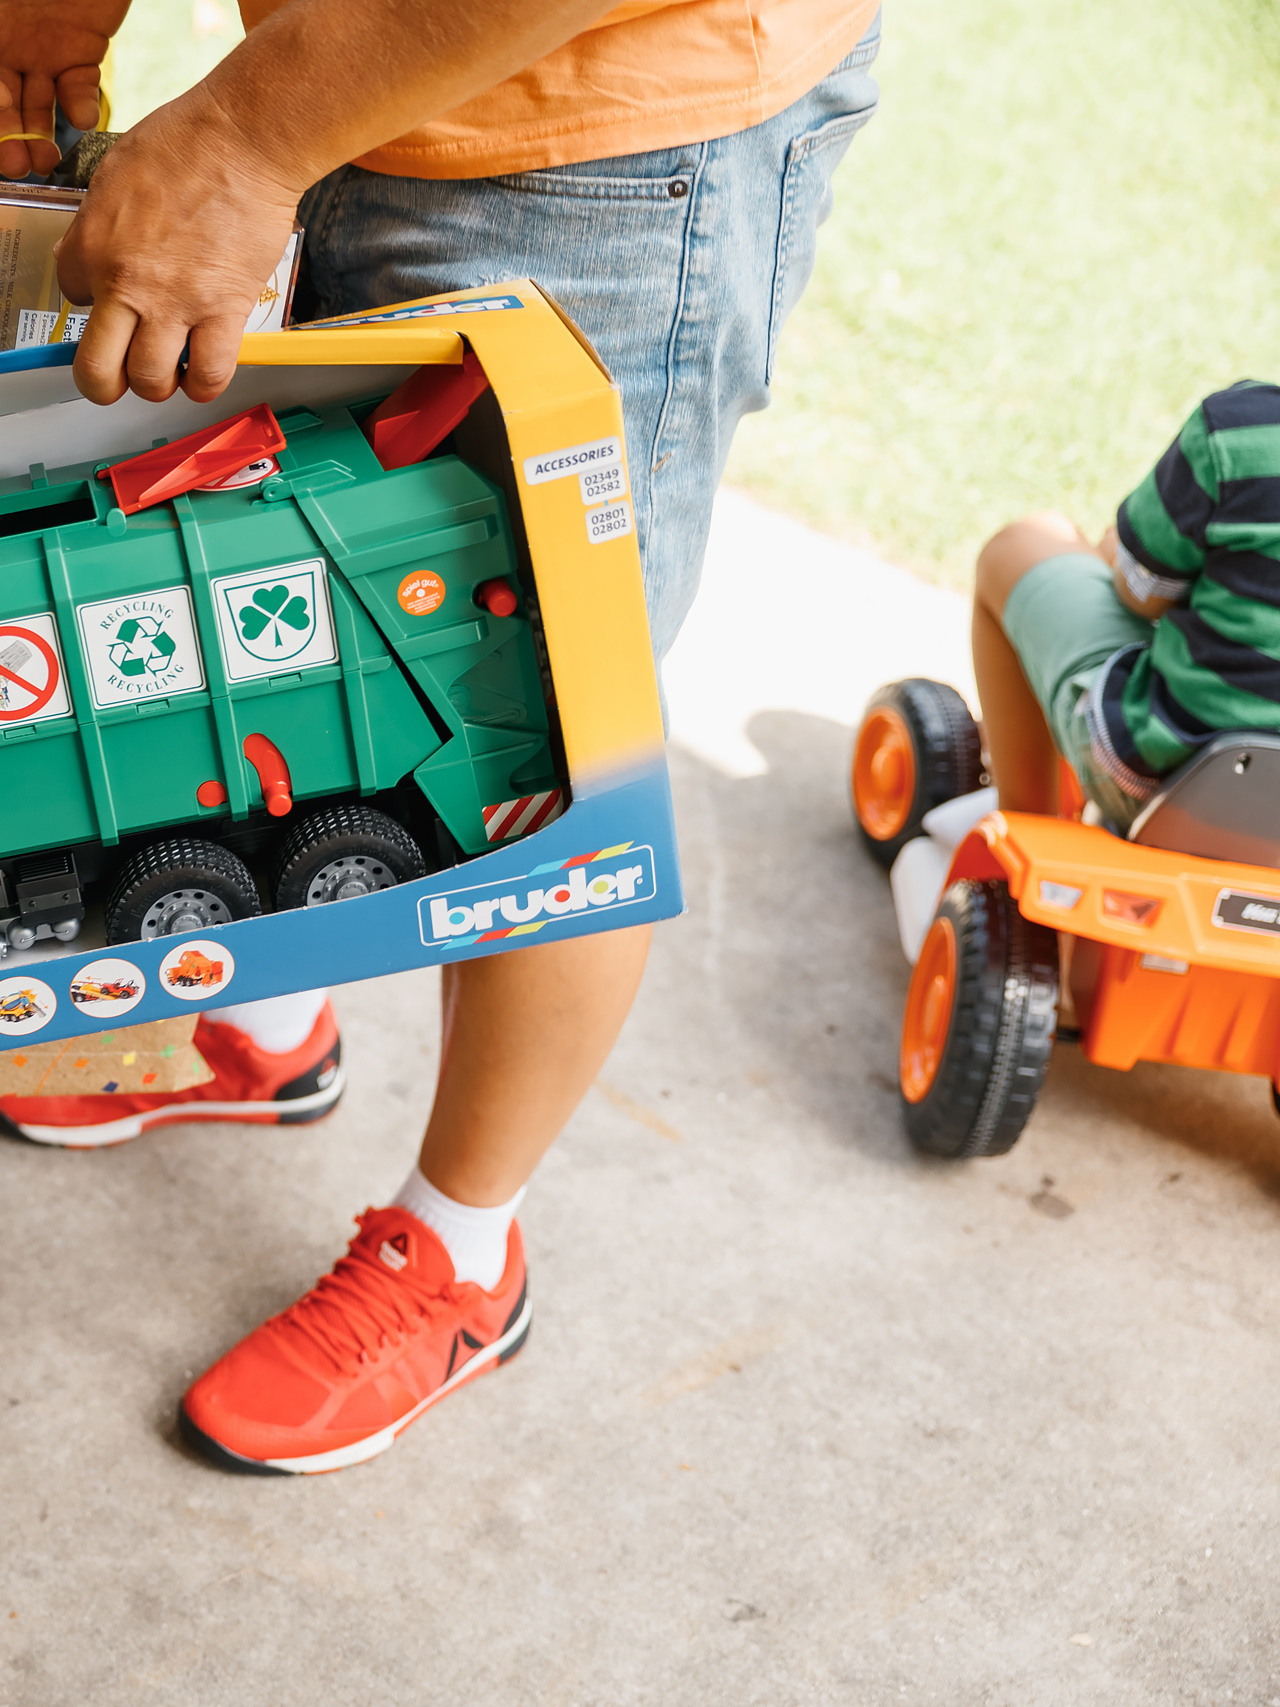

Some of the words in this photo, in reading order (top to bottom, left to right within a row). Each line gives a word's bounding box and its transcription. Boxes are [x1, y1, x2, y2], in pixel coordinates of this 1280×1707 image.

[29, 313, 37, 339] Calories
[535, 445, 614, 475] ACCESSORIES
[584, 468, 619, 486] 02349
[586, 480, 620, 497] 02582
[591, 507, 625, 525] 02801
[592, 518, 627, 536] 02802
[402, 579, 420, 597] spiel
[100, 601, 174, 630] RECYCLING
[107, 664, 184, 693] RECYCLING
[430, 865, 643, 939] bruder
